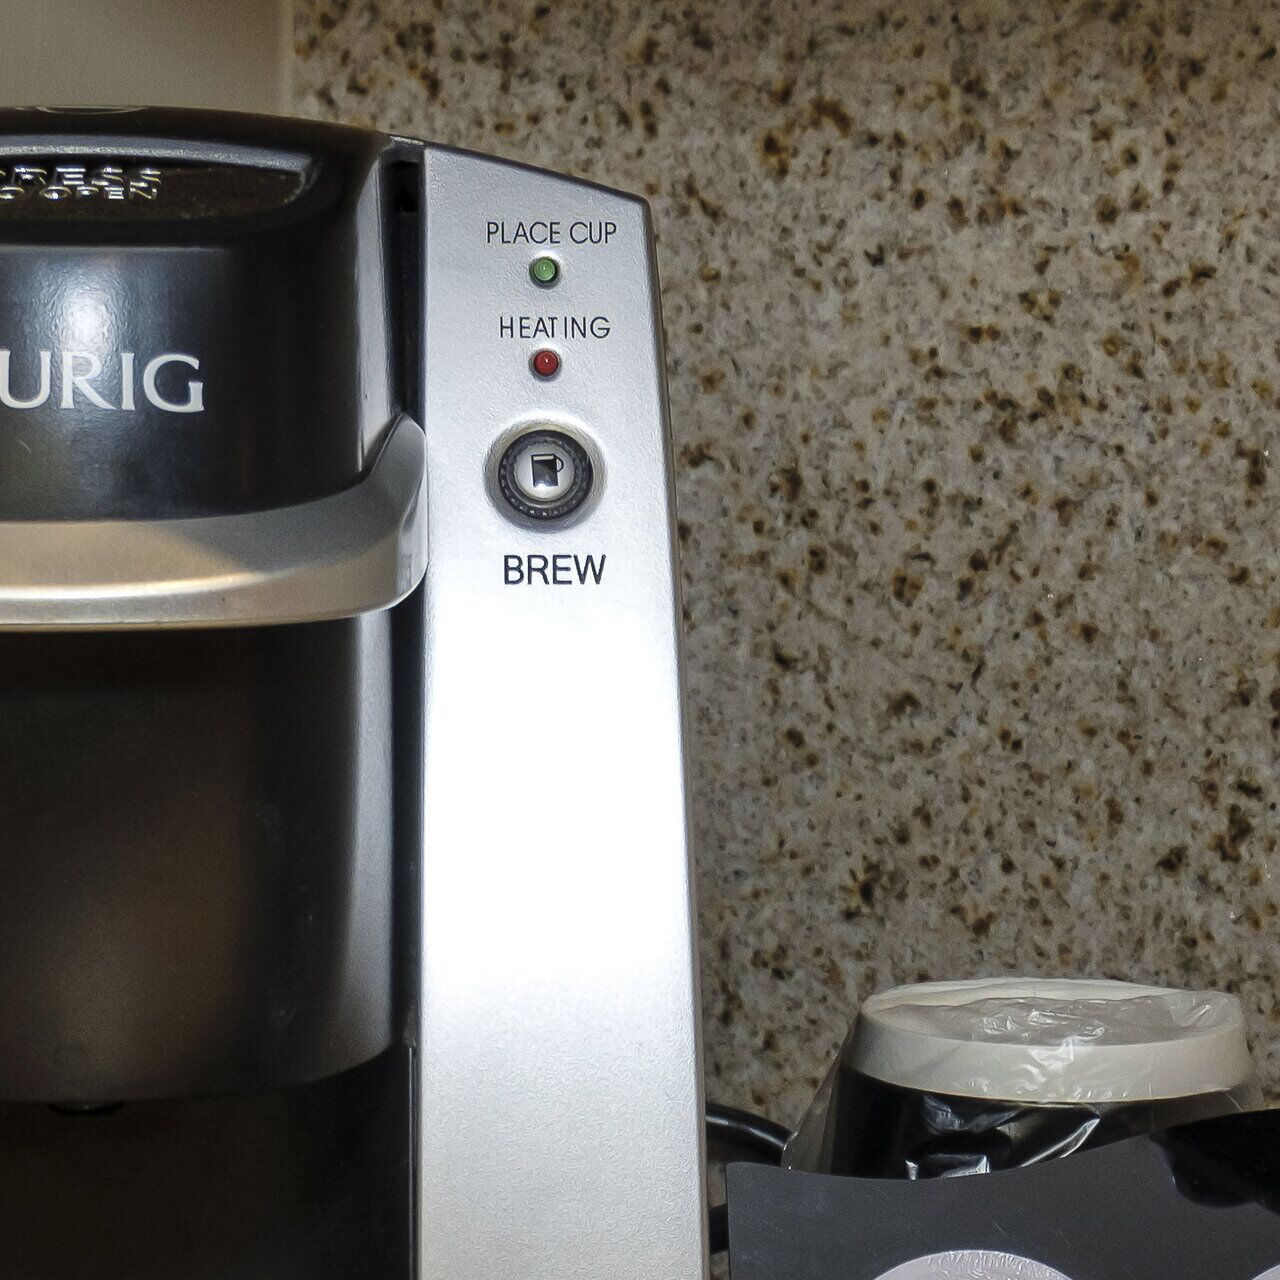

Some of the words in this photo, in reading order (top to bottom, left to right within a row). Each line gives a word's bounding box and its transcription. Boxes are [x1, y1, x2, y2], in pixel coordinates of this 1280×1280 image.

[486, 221, 561, 245] PLACE
[569, 221, 617, 245] CUP
[499, 315, 611, 340] HEATING
[503, 553, 607, 586] BREW
